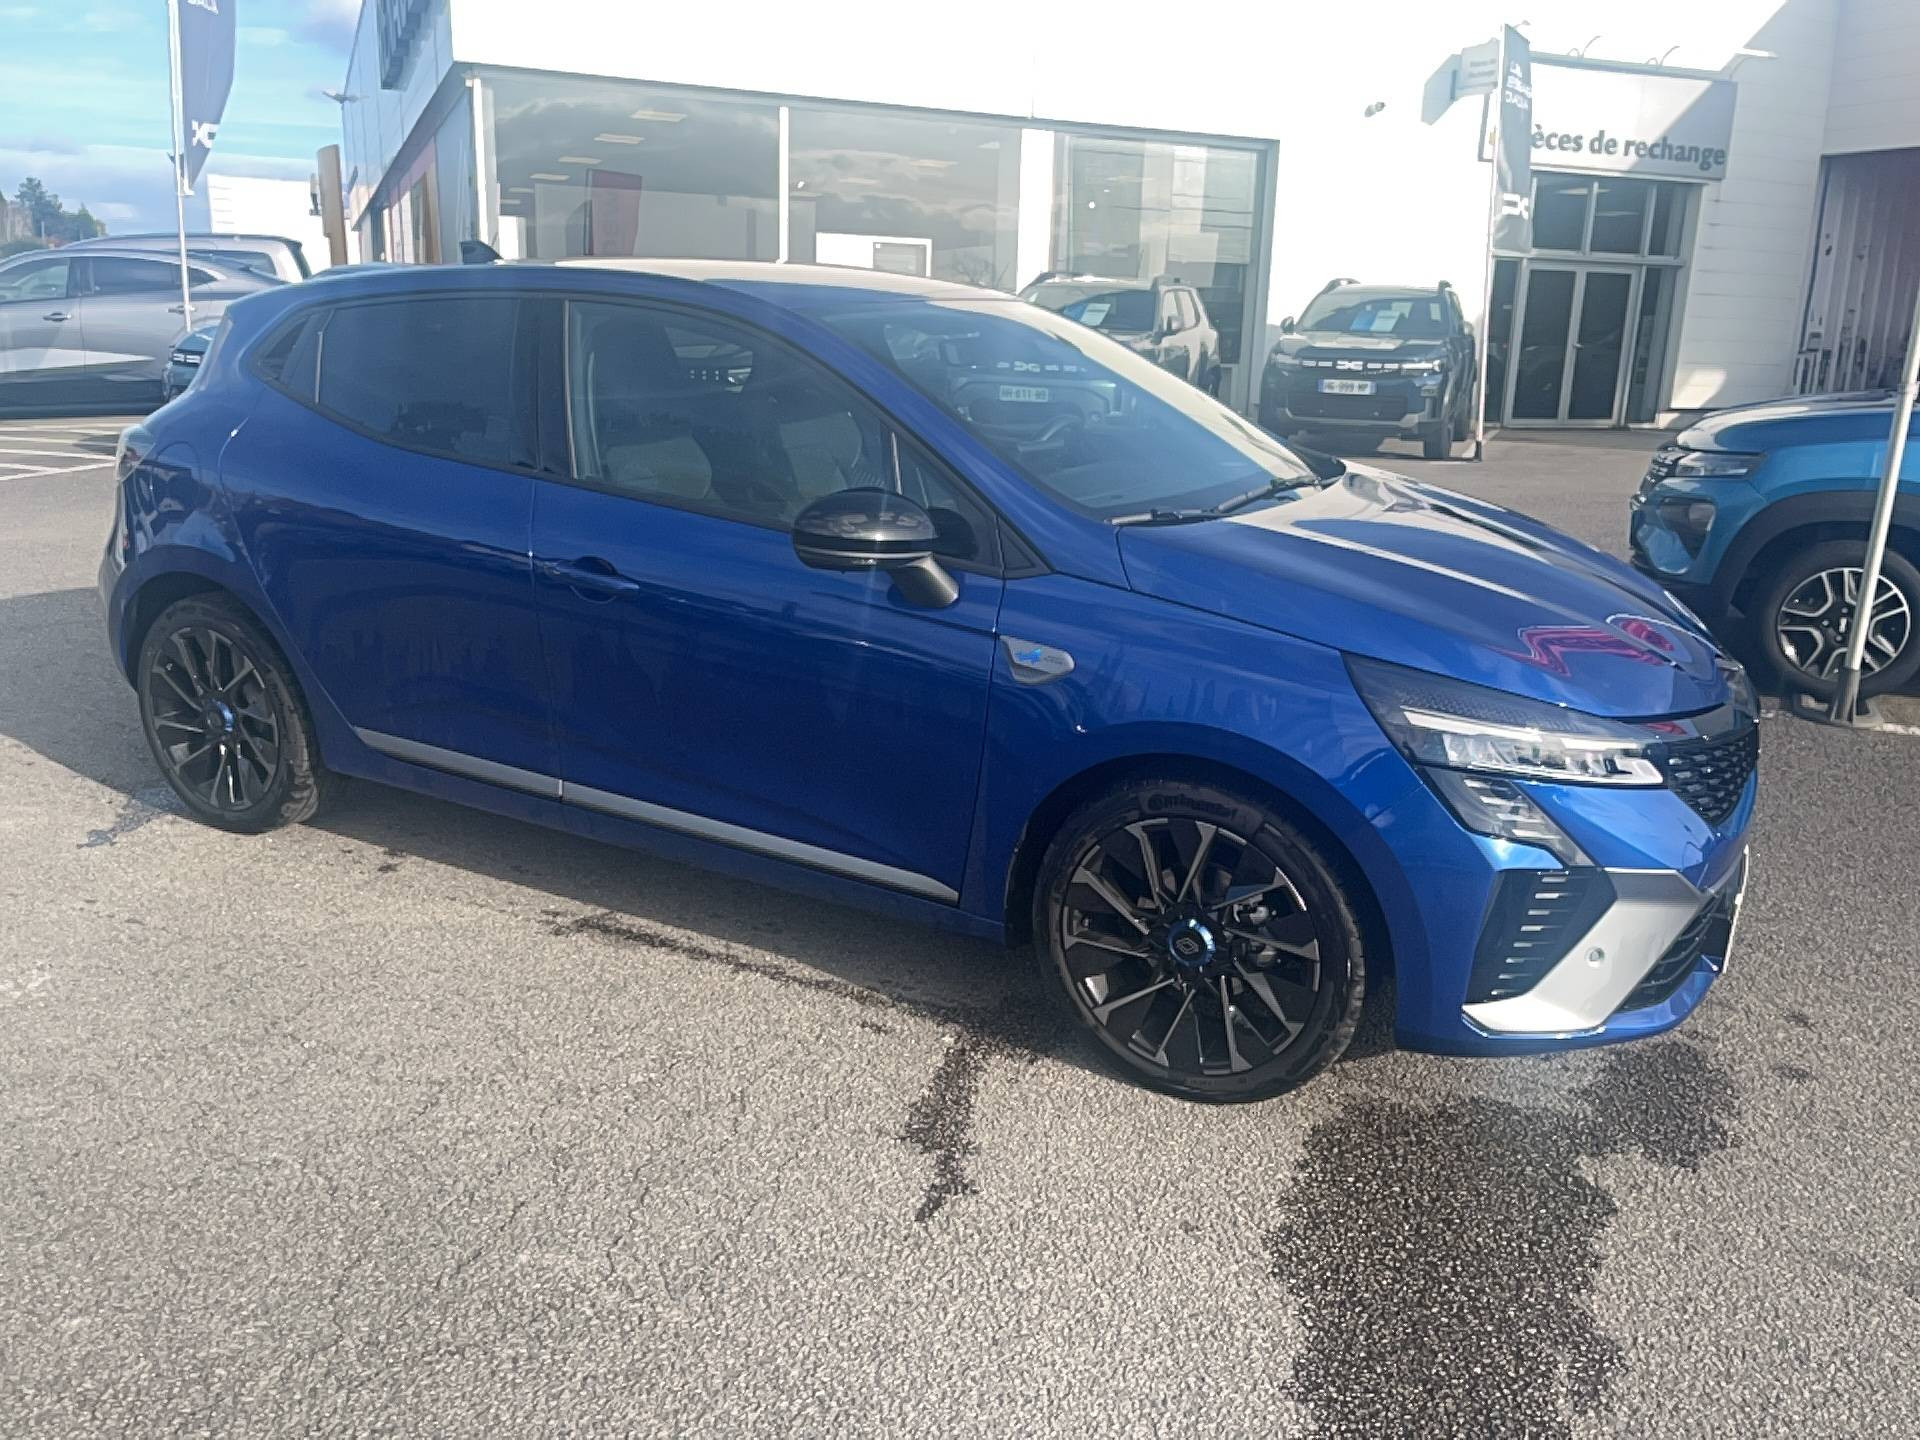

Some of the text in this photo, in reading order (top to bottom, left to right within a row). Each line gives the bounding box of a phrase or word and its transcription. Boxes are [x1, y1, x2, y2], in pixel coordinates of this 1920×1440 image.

[1531, 123, 1726, 171] èces de rechange
